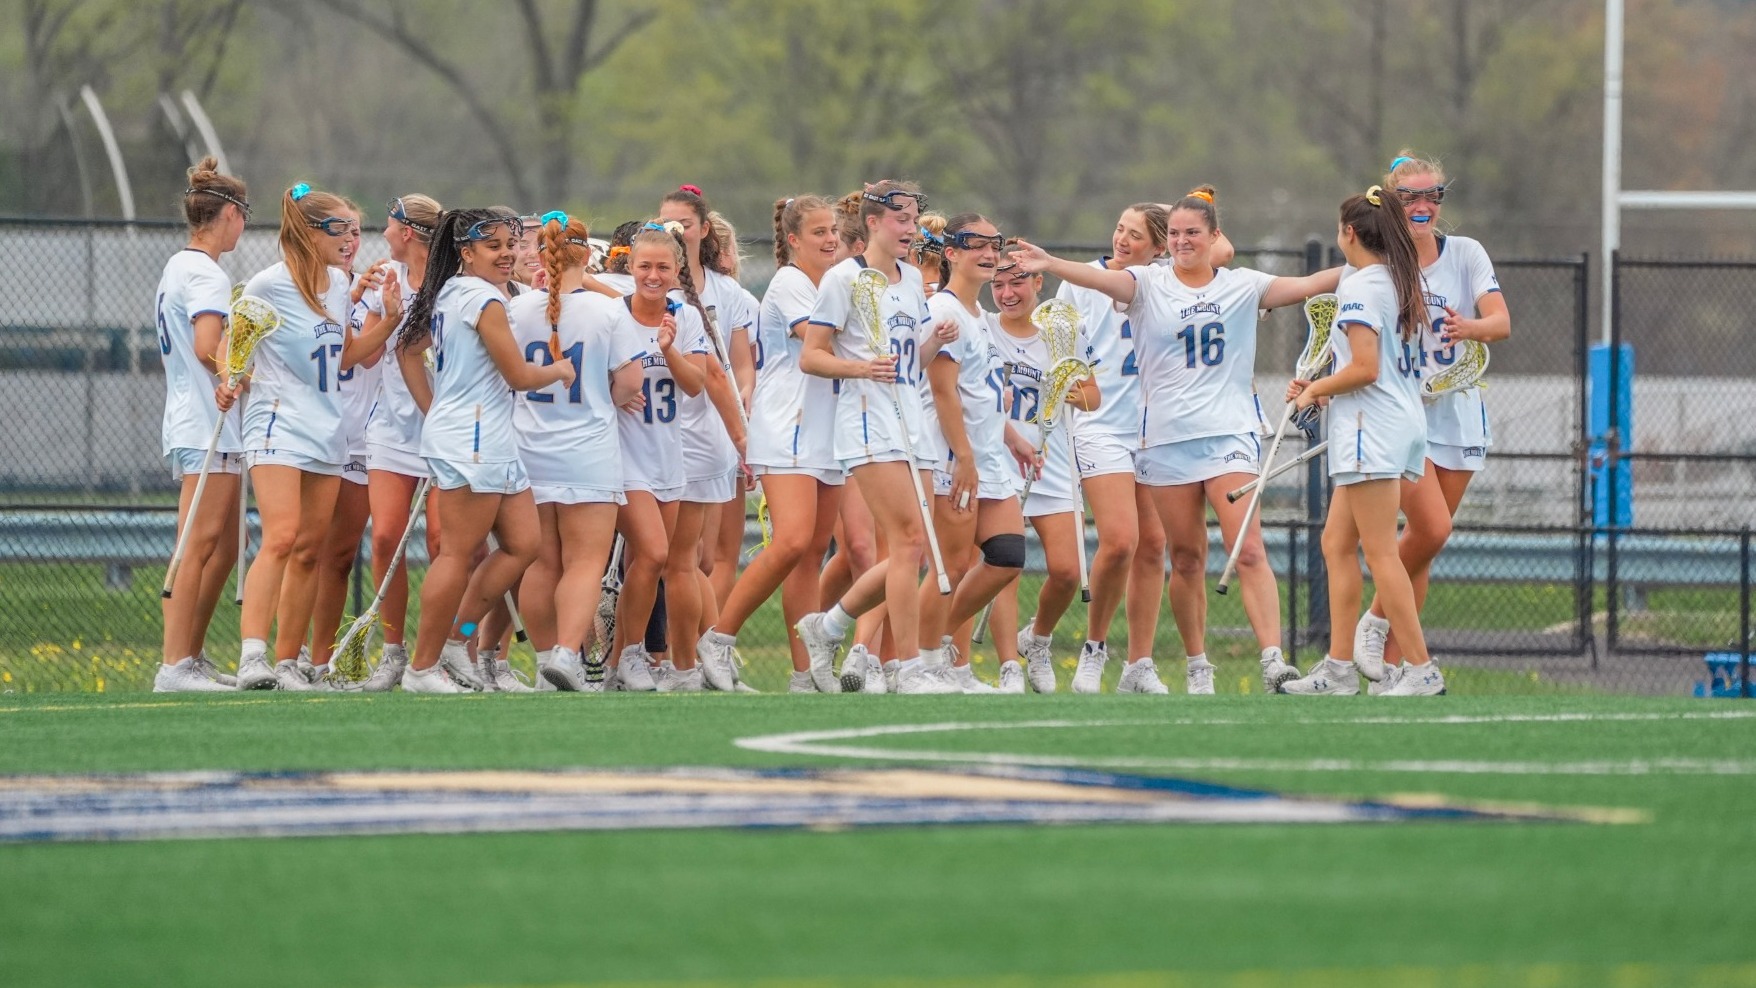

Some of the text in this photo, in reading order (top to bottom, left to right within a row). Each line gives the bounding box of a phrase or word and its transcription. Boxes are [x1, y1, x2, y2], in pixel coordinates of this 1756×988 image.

[158, 292, 172, 355] 5
[314, 325, 326, 338] THE
[1181, 304, 1221, 319] THE MOUNT
[642, 357, 653, 369] HE
[1176, 322, 1226, 369] 16
[525, 341, 584, 404] 21
[1016, 364, 1042, 382] MOUNT
[642, 377, 677, 425] 13
[1008, 379, 1039, 424] 12
